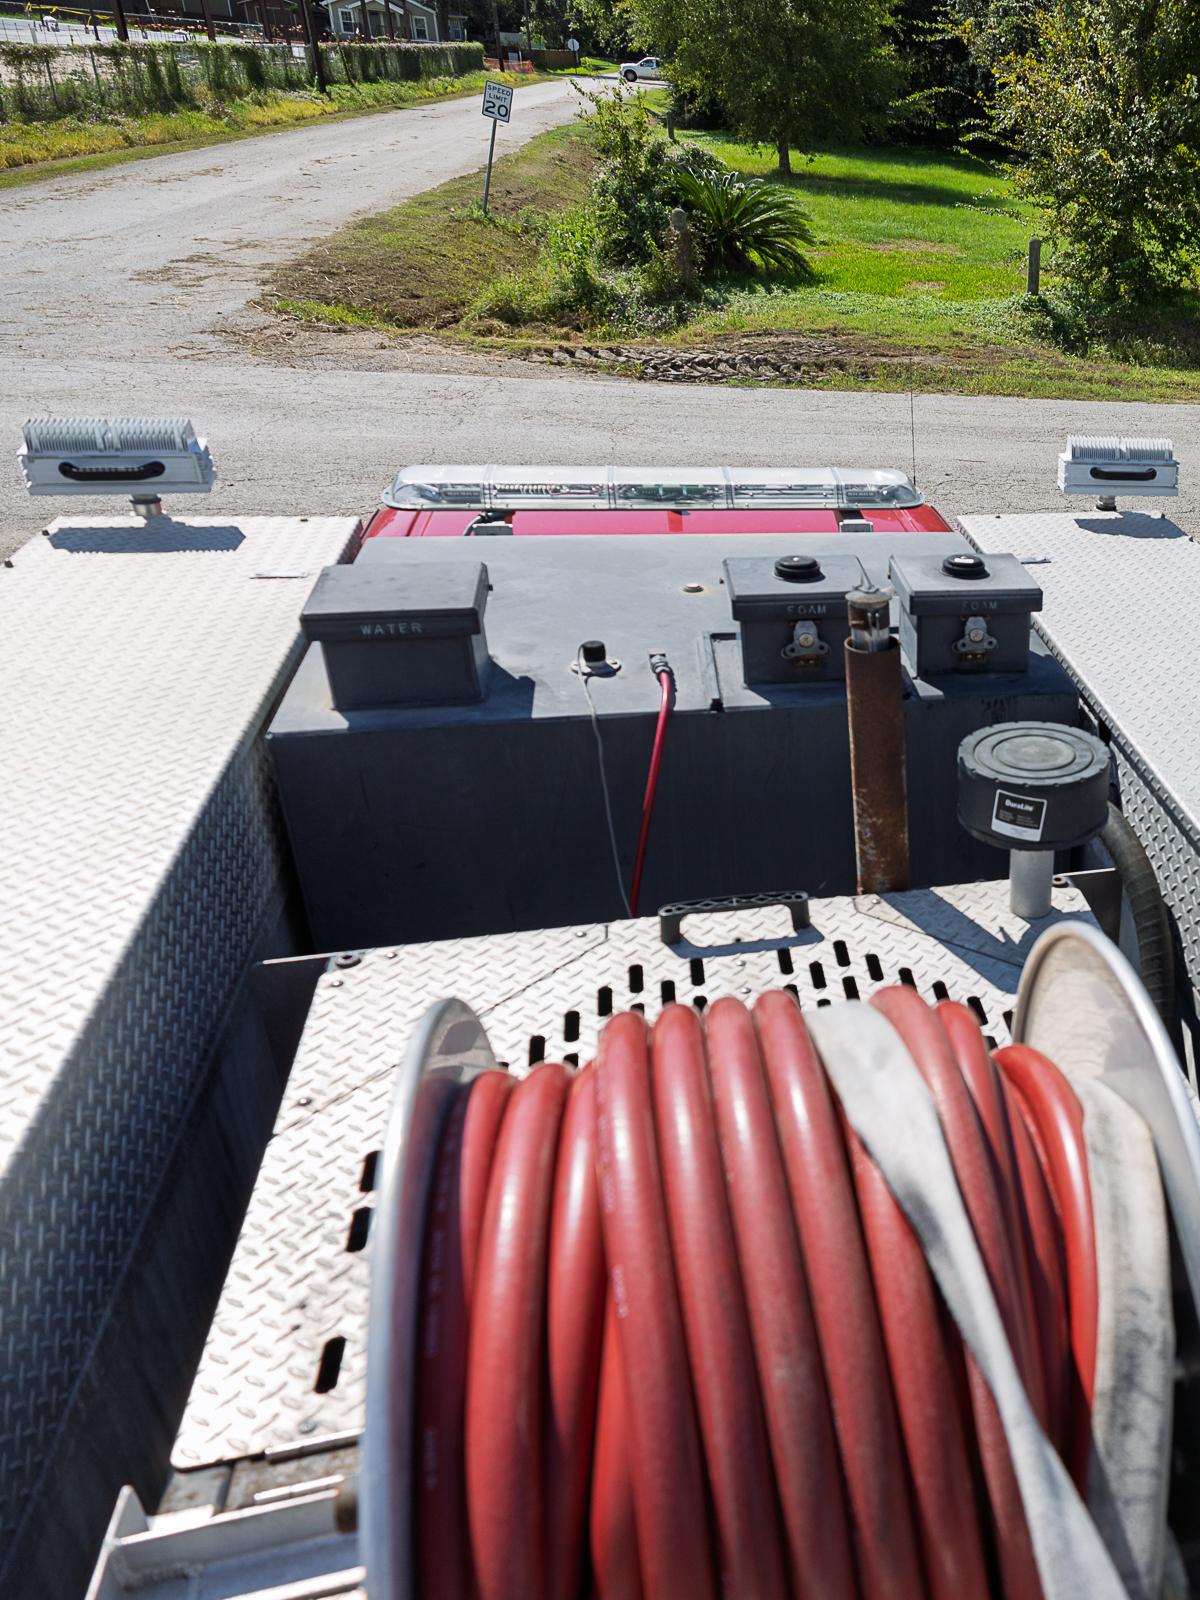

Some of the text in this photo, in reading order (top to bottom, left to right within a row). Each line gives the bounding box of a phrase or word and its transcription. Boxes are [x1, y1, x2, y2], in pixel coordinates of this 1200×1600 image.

[487, 85, 510, 96] SPEED
[489, 93, 508, 103] LIMIT
[485, 100, 508, 117] 20
[787, 604, 826, 615] FOAM
[360, 622, 424, 635] WATER
